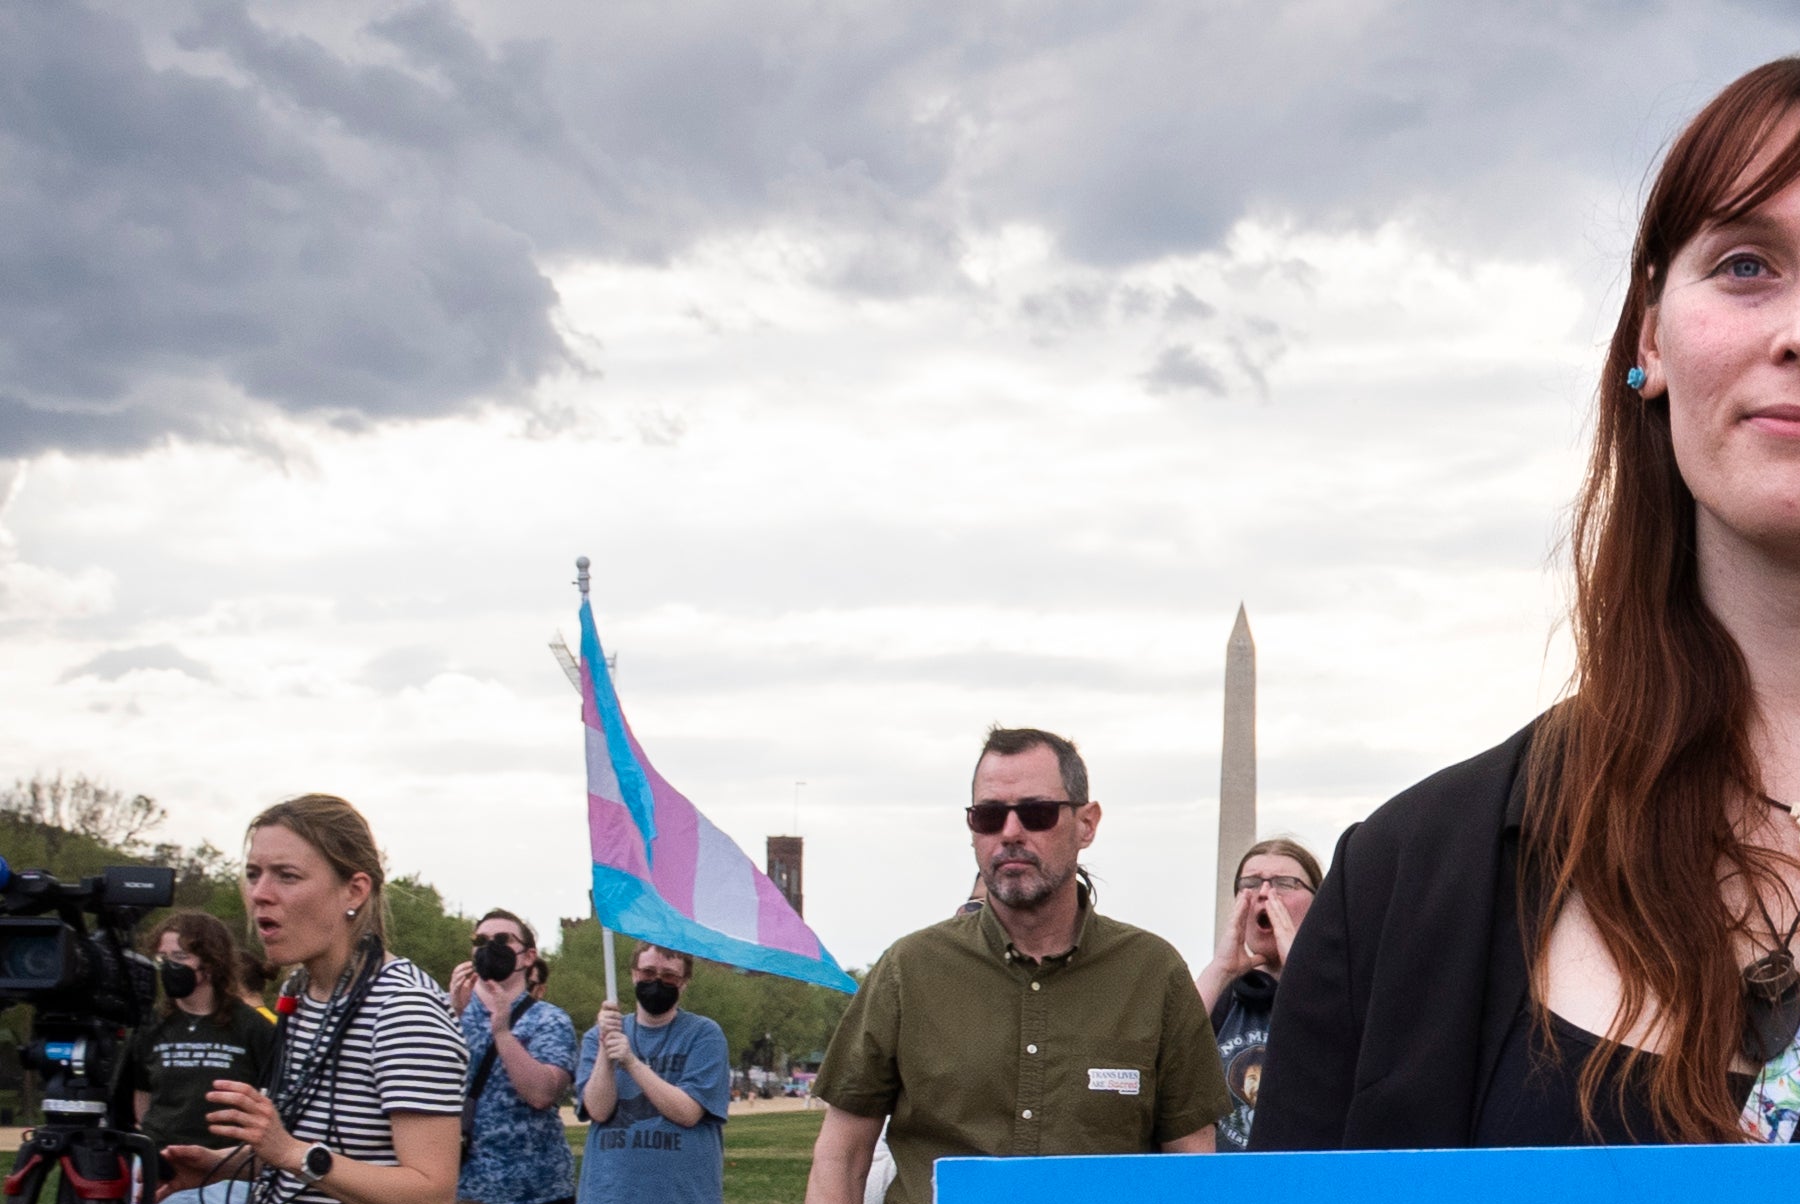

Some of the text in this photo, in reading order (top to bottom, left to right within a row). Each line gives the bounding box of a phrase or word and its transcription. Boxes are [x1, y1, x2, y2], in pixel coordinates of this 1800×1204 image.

[162, 1060, 200, 1068] WTHOUT
[1117, 1071, 1139, 1080] LIVES
[631, 1129, 682, 1152] ALONE
